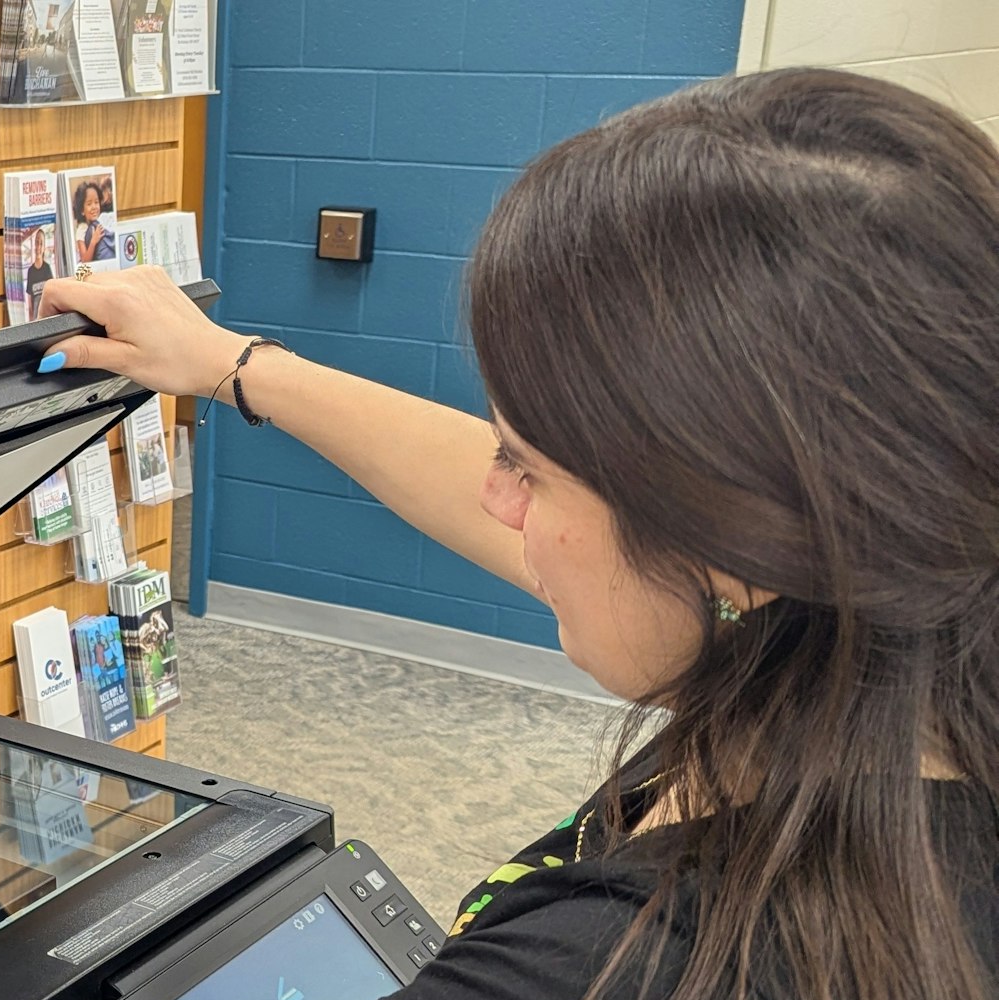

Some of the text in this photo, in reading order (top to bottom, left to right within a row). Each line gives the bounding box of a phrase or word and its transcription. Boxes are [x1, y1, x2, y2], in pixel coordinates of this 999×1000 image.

[23, 180, 46, 194] REMOVING
[29, 192, 52, 206] BARRIERS
[40, 677, 73, 698] outcenter
